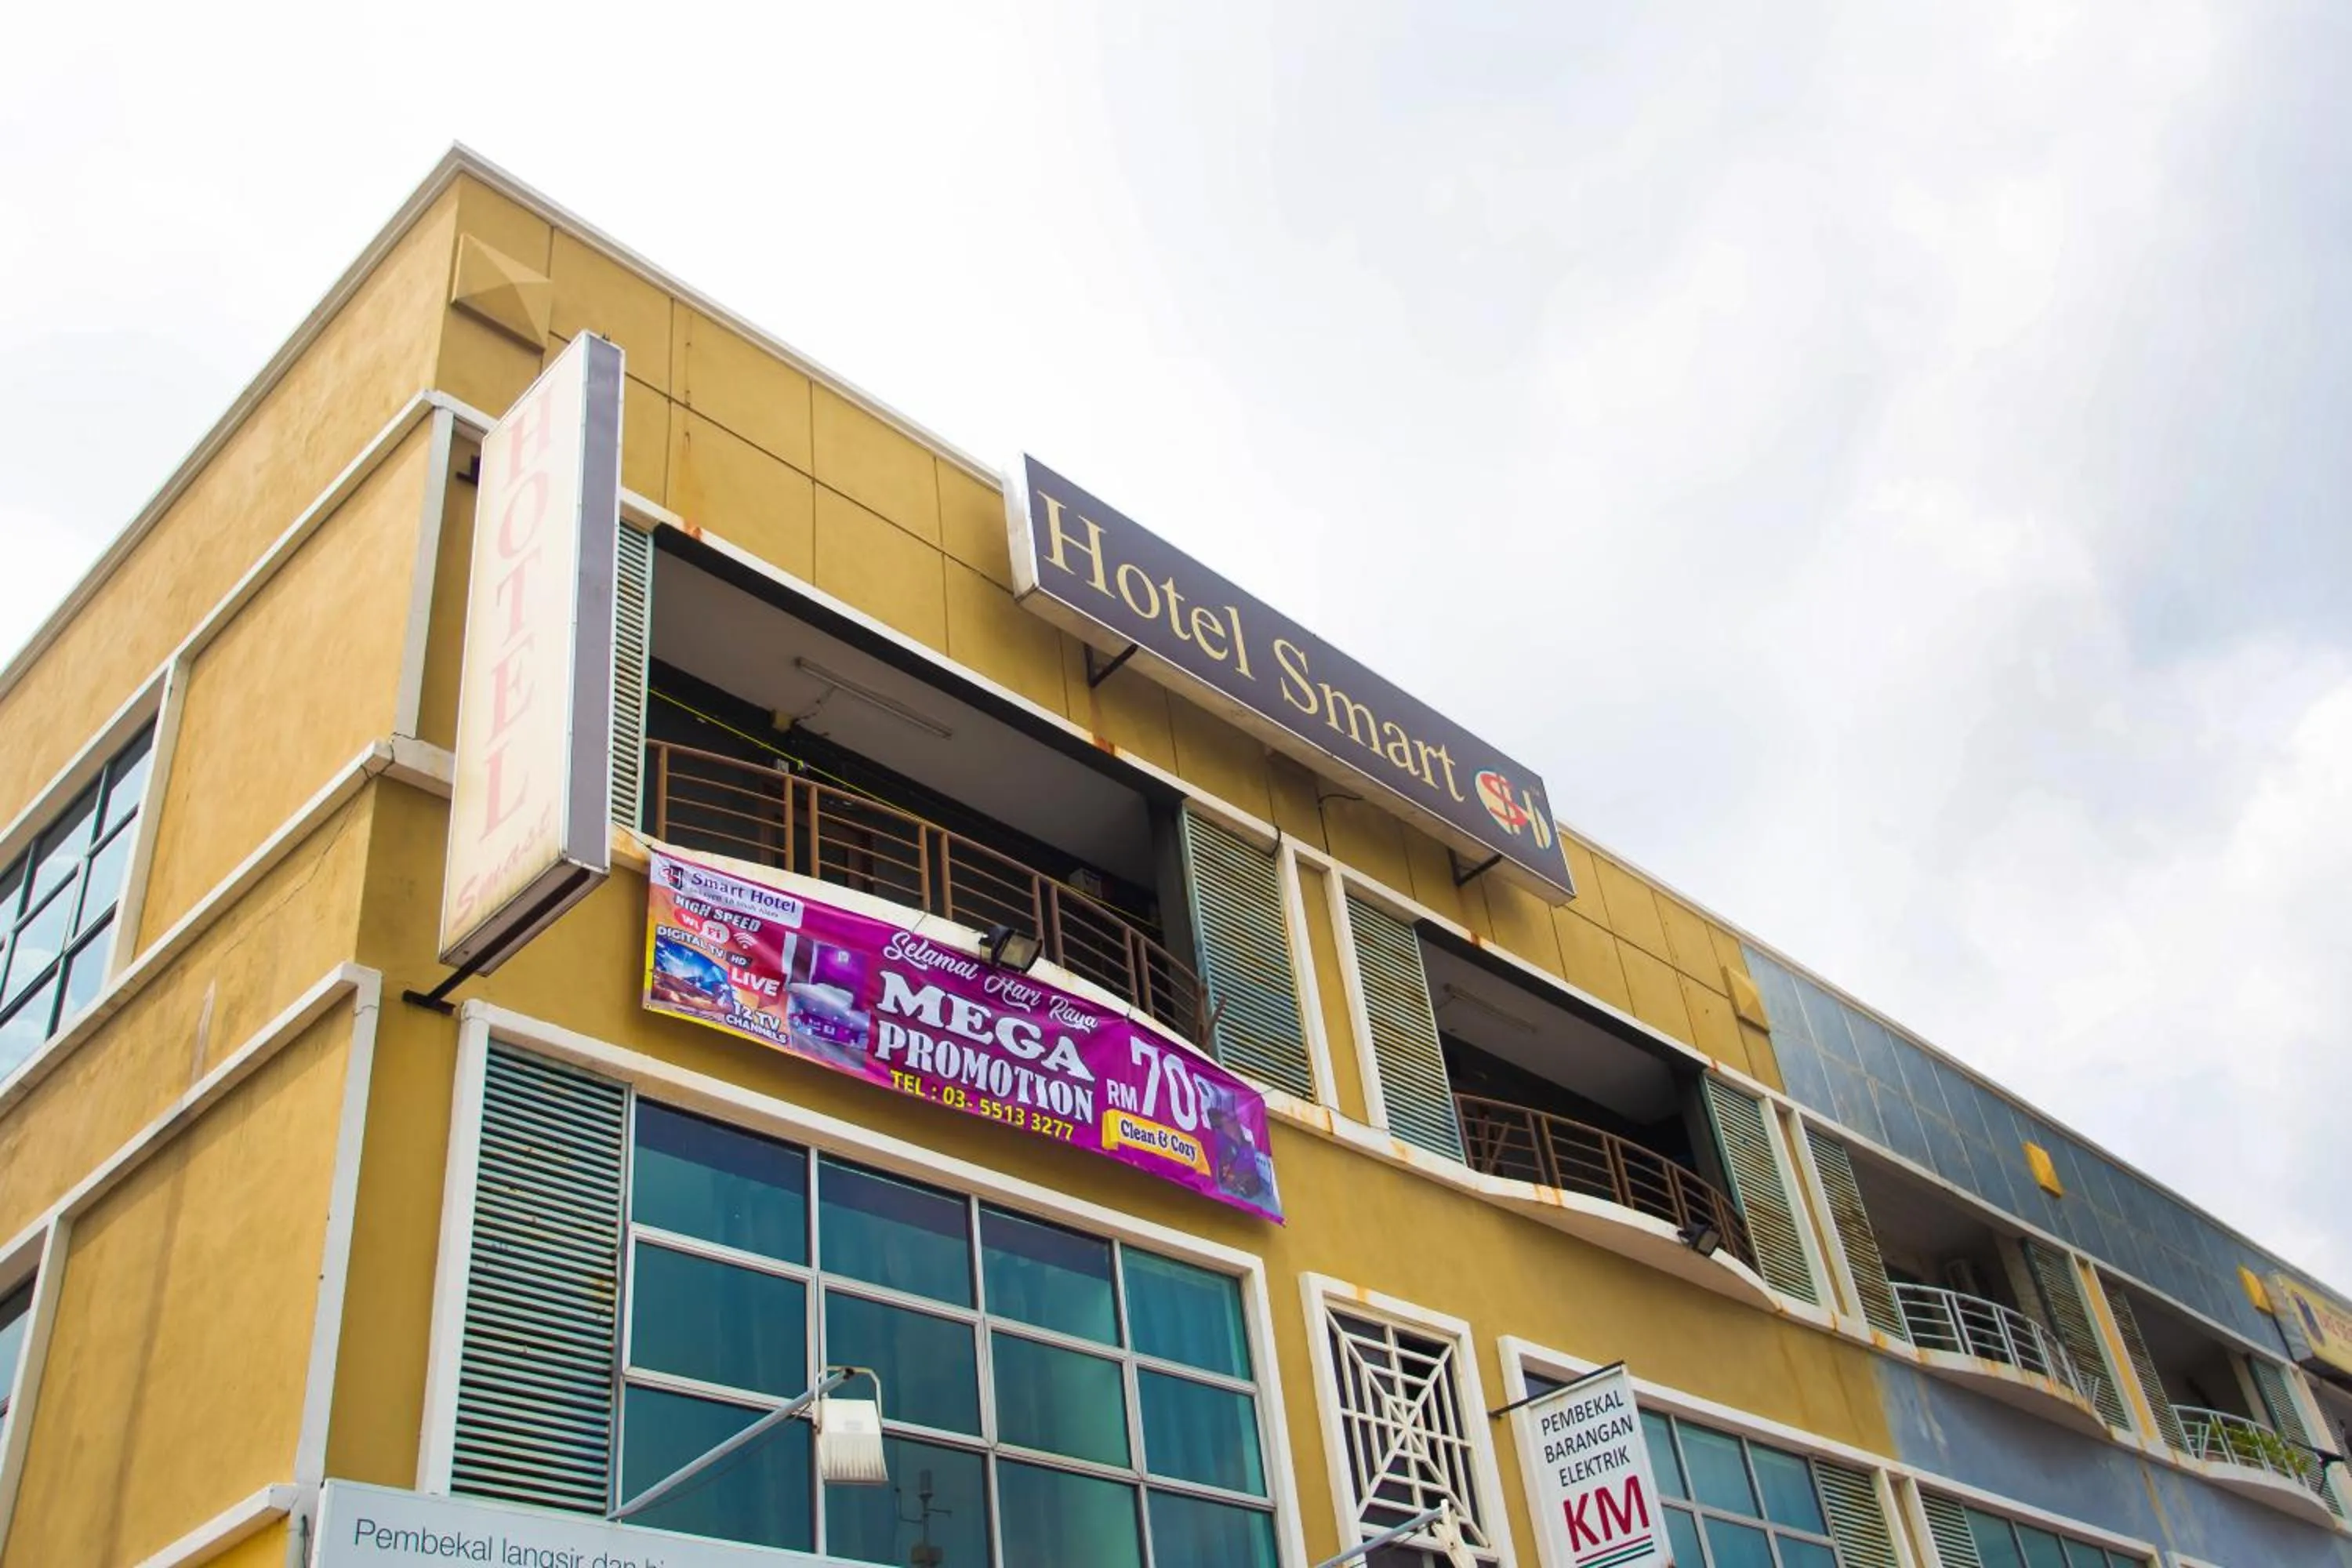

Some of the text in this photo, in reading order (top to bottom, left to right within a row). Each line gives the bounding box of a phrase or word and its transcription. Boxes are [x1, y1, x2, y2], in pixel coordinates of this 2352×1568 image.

[478, 385, 551, 844] HOTEL
[1037, 490, 1256, 681] Hotel
[1273, 637, 1465, 802] Smart
[674, 895, 710, 918] HIGH
[713, 908, 761, 932] SPEED
[691, 872, 744, 898] Smart
[750, 889, 796, 913] Hotel
[657, 925, 747, 966] DIGITAL TV HD
[731, 966, 780, 996] LIVE
[733, 1000, 753, 1020] 12
[755, 1011, 781, 1031] TV
[877, 971, 1095, 1081] MEGA
[983, 975, 1041, 1012] Hari
[1049, 995, 1098, 1033] Raya
[726, 1014, 787, 1044] CHANNELS
[875, 1020, 1094, 1124] PROMOTION
[890, 1069, 926, 1097] TEL
[980, 1098, 1025, 1126] 5513
[1031, 1112, 1074, 1141] 3277
[1106, 1078, 1138, 1112] RM
[1120, 1119, 1196, 1162] Clean & Cozy
[1541, 1389, 1625, 1436] PEMBEKAL
[1544, 1414, 1634, 1464] BARANGAN
[1559, 1445, 1631, 1487] ELEKTRIK
[1563, 1474, 1650, 1553] KM
[354, 1518, 493, 1563] Pembekal
